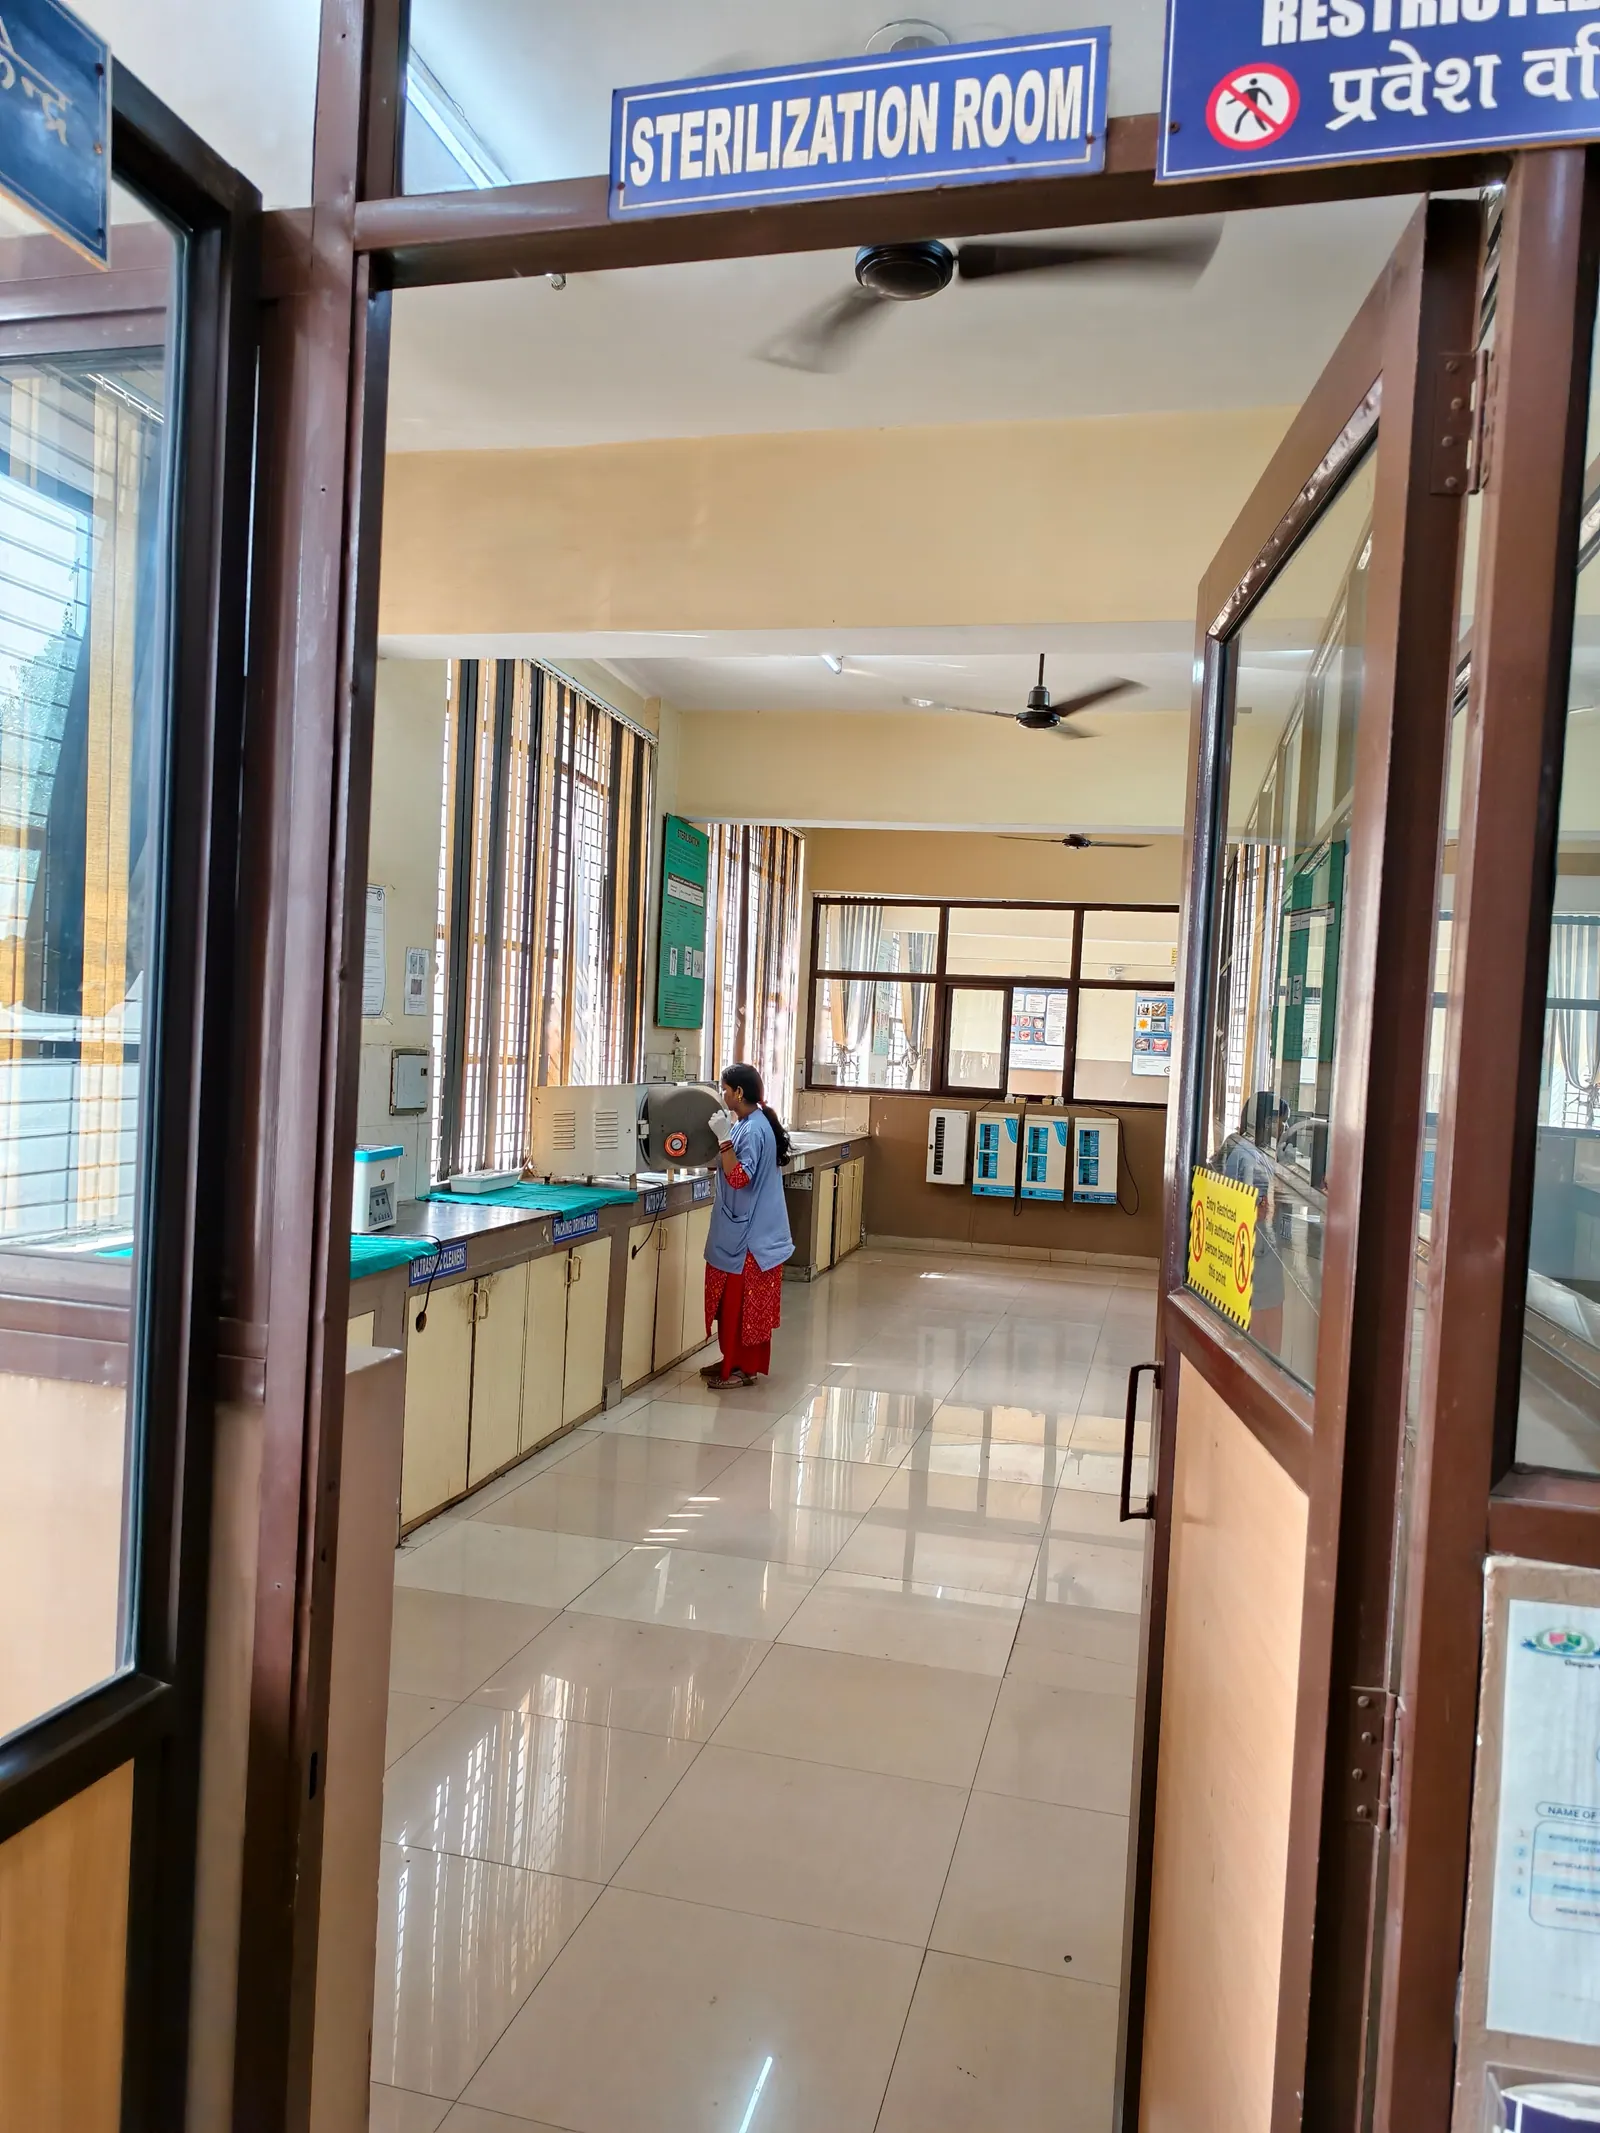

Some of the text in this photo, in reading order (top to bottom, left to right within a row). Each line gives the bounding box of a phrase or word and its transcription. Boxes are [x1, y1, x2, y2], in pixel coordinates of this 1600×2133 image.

[1325, 40, 1502, 131] प्रवेश
[629, 66, 1084, 187] STERILIZATION ROOM
[1206, 1196, 1237, 1223] Entry Restricted
[1205, 1217, 1214, 1235] Only
[1205, 1241, 1233, 1268] person beyond
[1208, 1263, 1216, 1279] this
[1547, 1806, 1597, 1820] NAME OF
